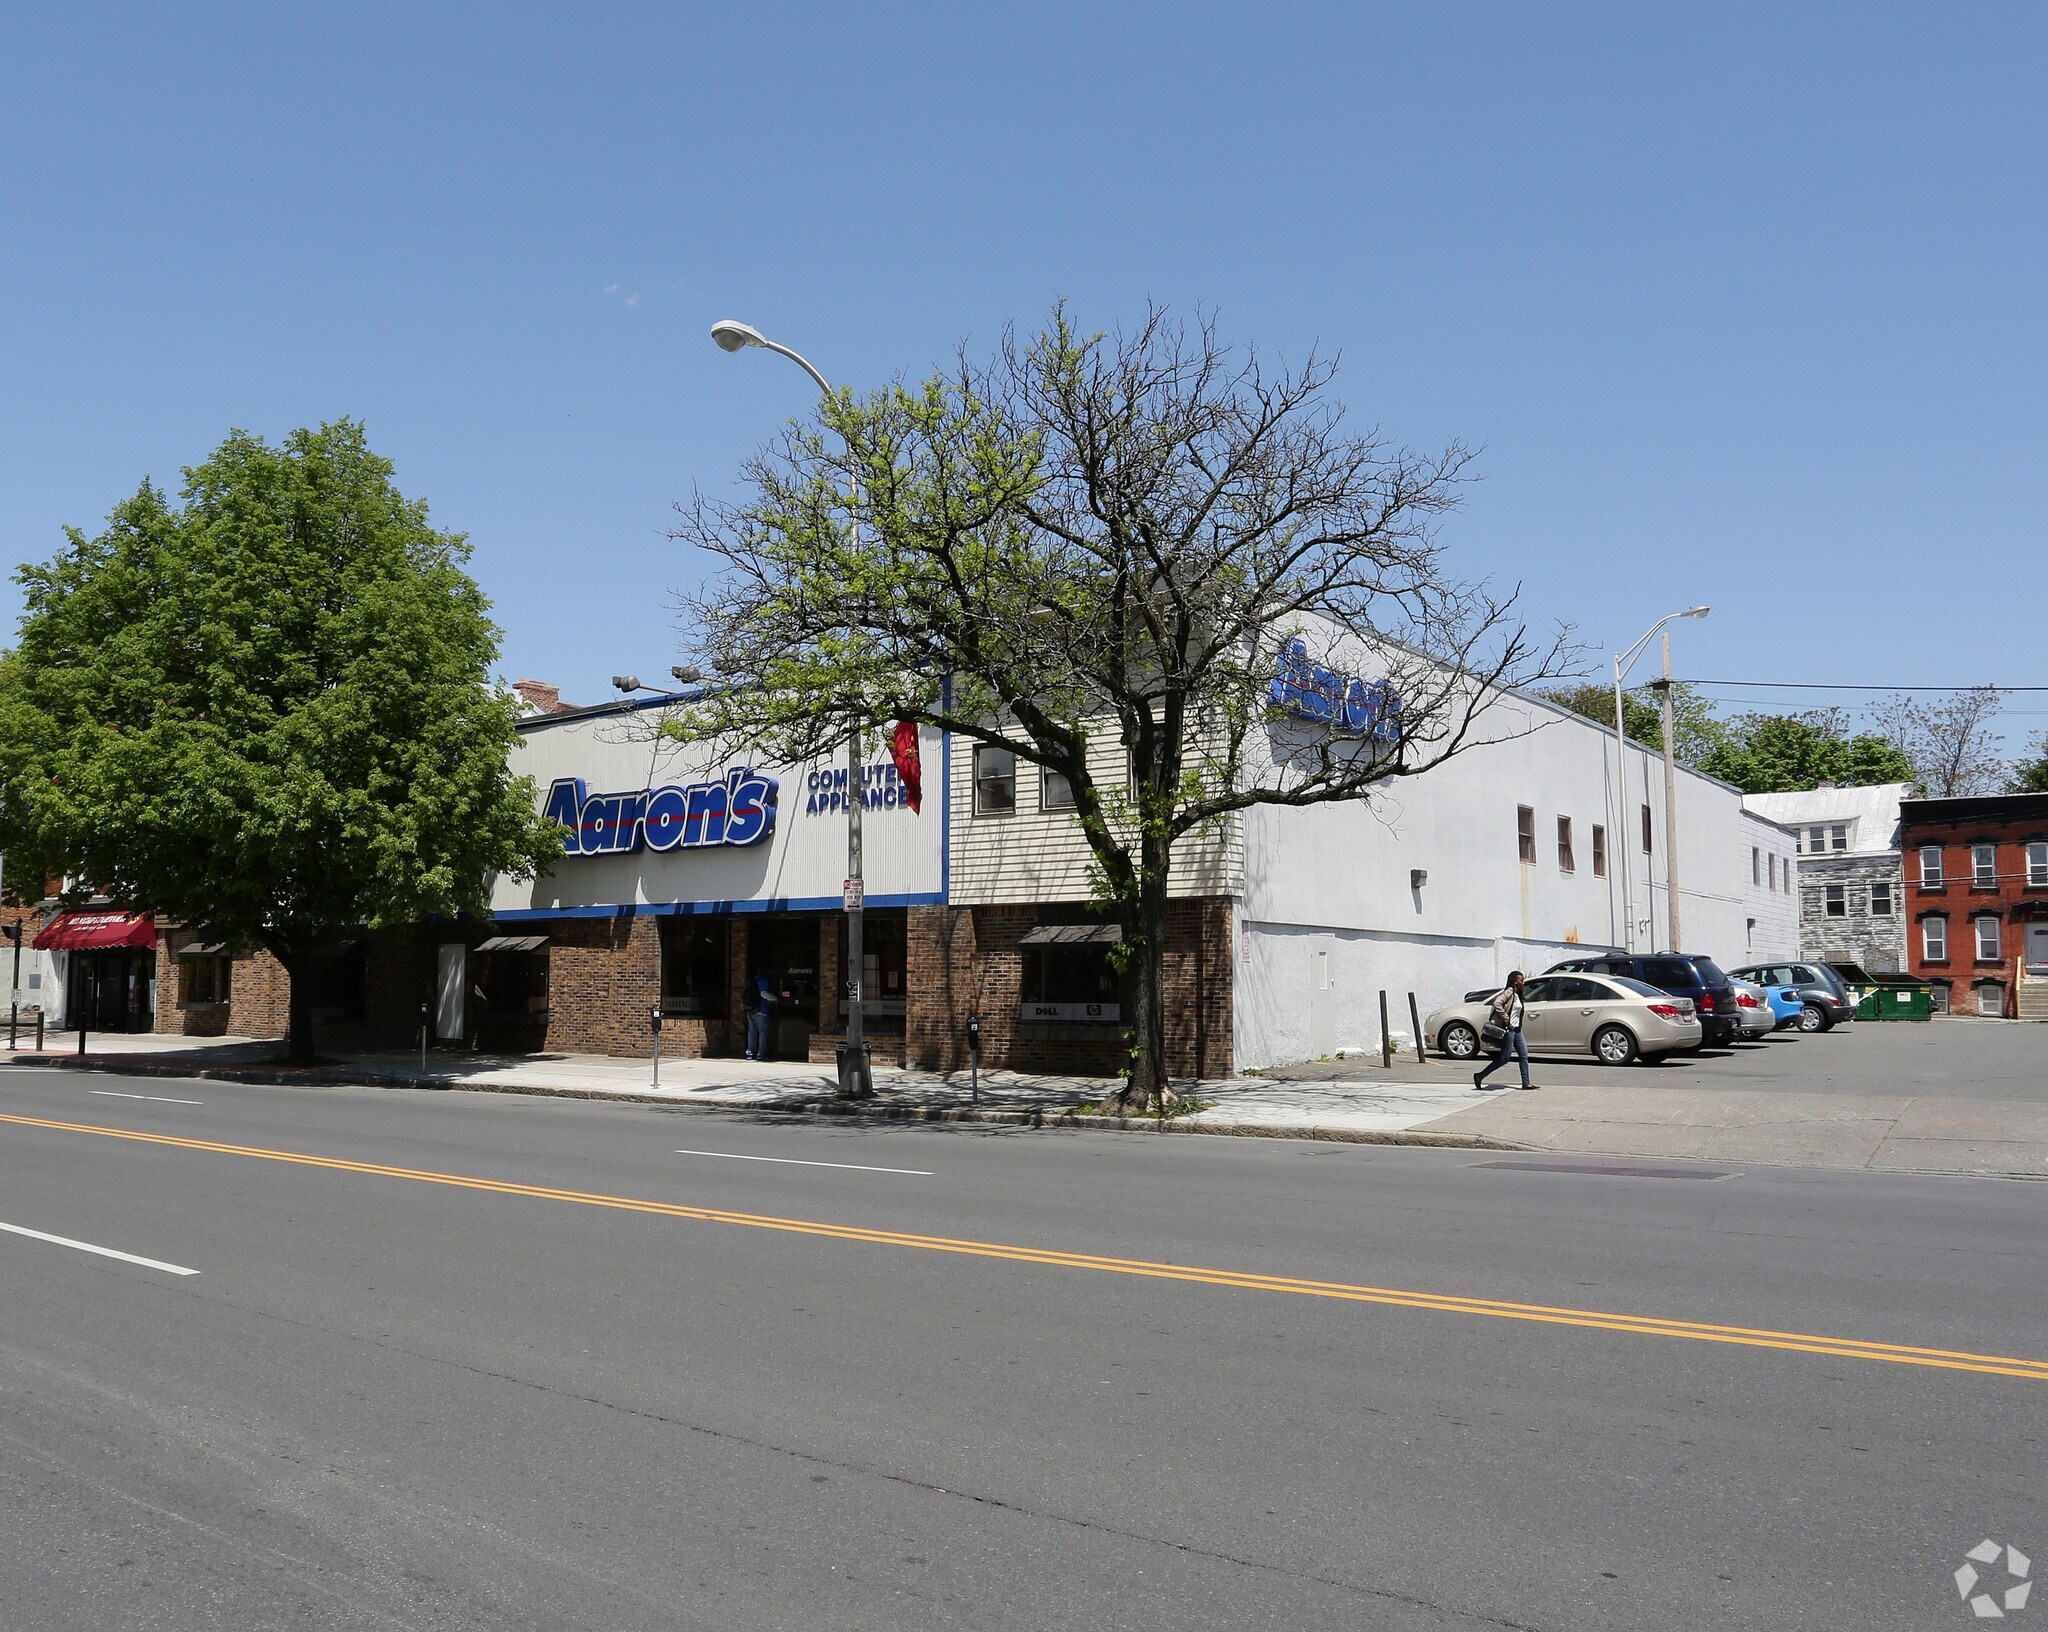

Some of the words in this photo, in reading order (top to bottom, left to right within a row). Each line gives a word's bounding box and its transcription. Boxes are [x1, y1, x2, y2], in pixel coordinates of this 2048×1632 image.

[807, 763, 903, 790] COMUTE
[542, 767, 777, 857] Aaron's
[806, 786, 909, 813] APPLANCE
